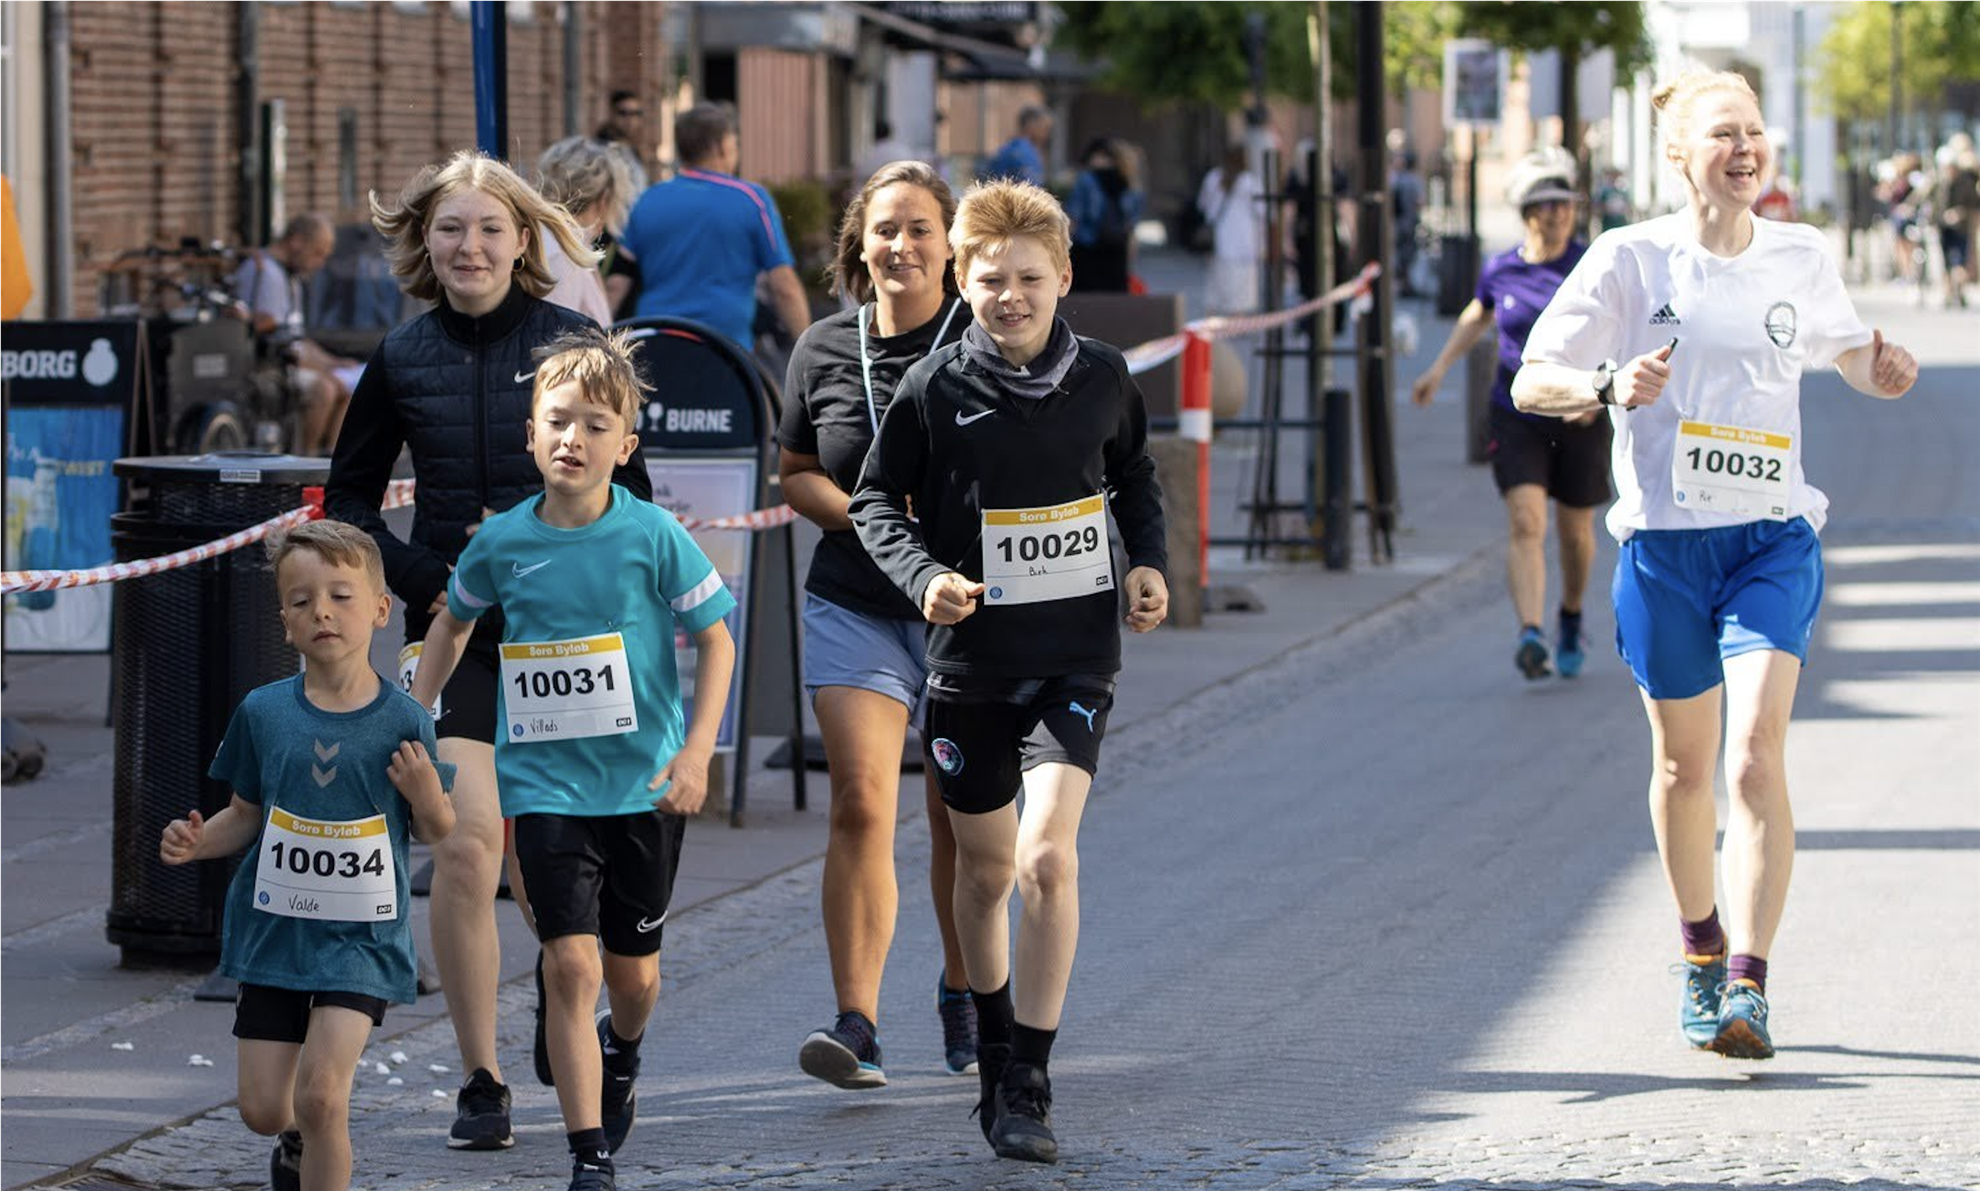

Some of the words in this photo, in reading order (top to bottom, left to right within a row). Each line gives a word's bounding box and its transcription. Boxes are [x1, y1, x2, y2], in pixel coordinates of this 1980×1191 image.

[1649, 317, 1681, 325] adidas
[0, 350, 77, 379] BORG
[666, 409, 732, 432] BURNE
[1687, 447, 1781, 482] 10032
[997, 526, 1098, 562] 10029
[514, 664, 616, 698] 10031
[271, 841, 384, 878] 10034
[289, 894, 320, 912] Valde
